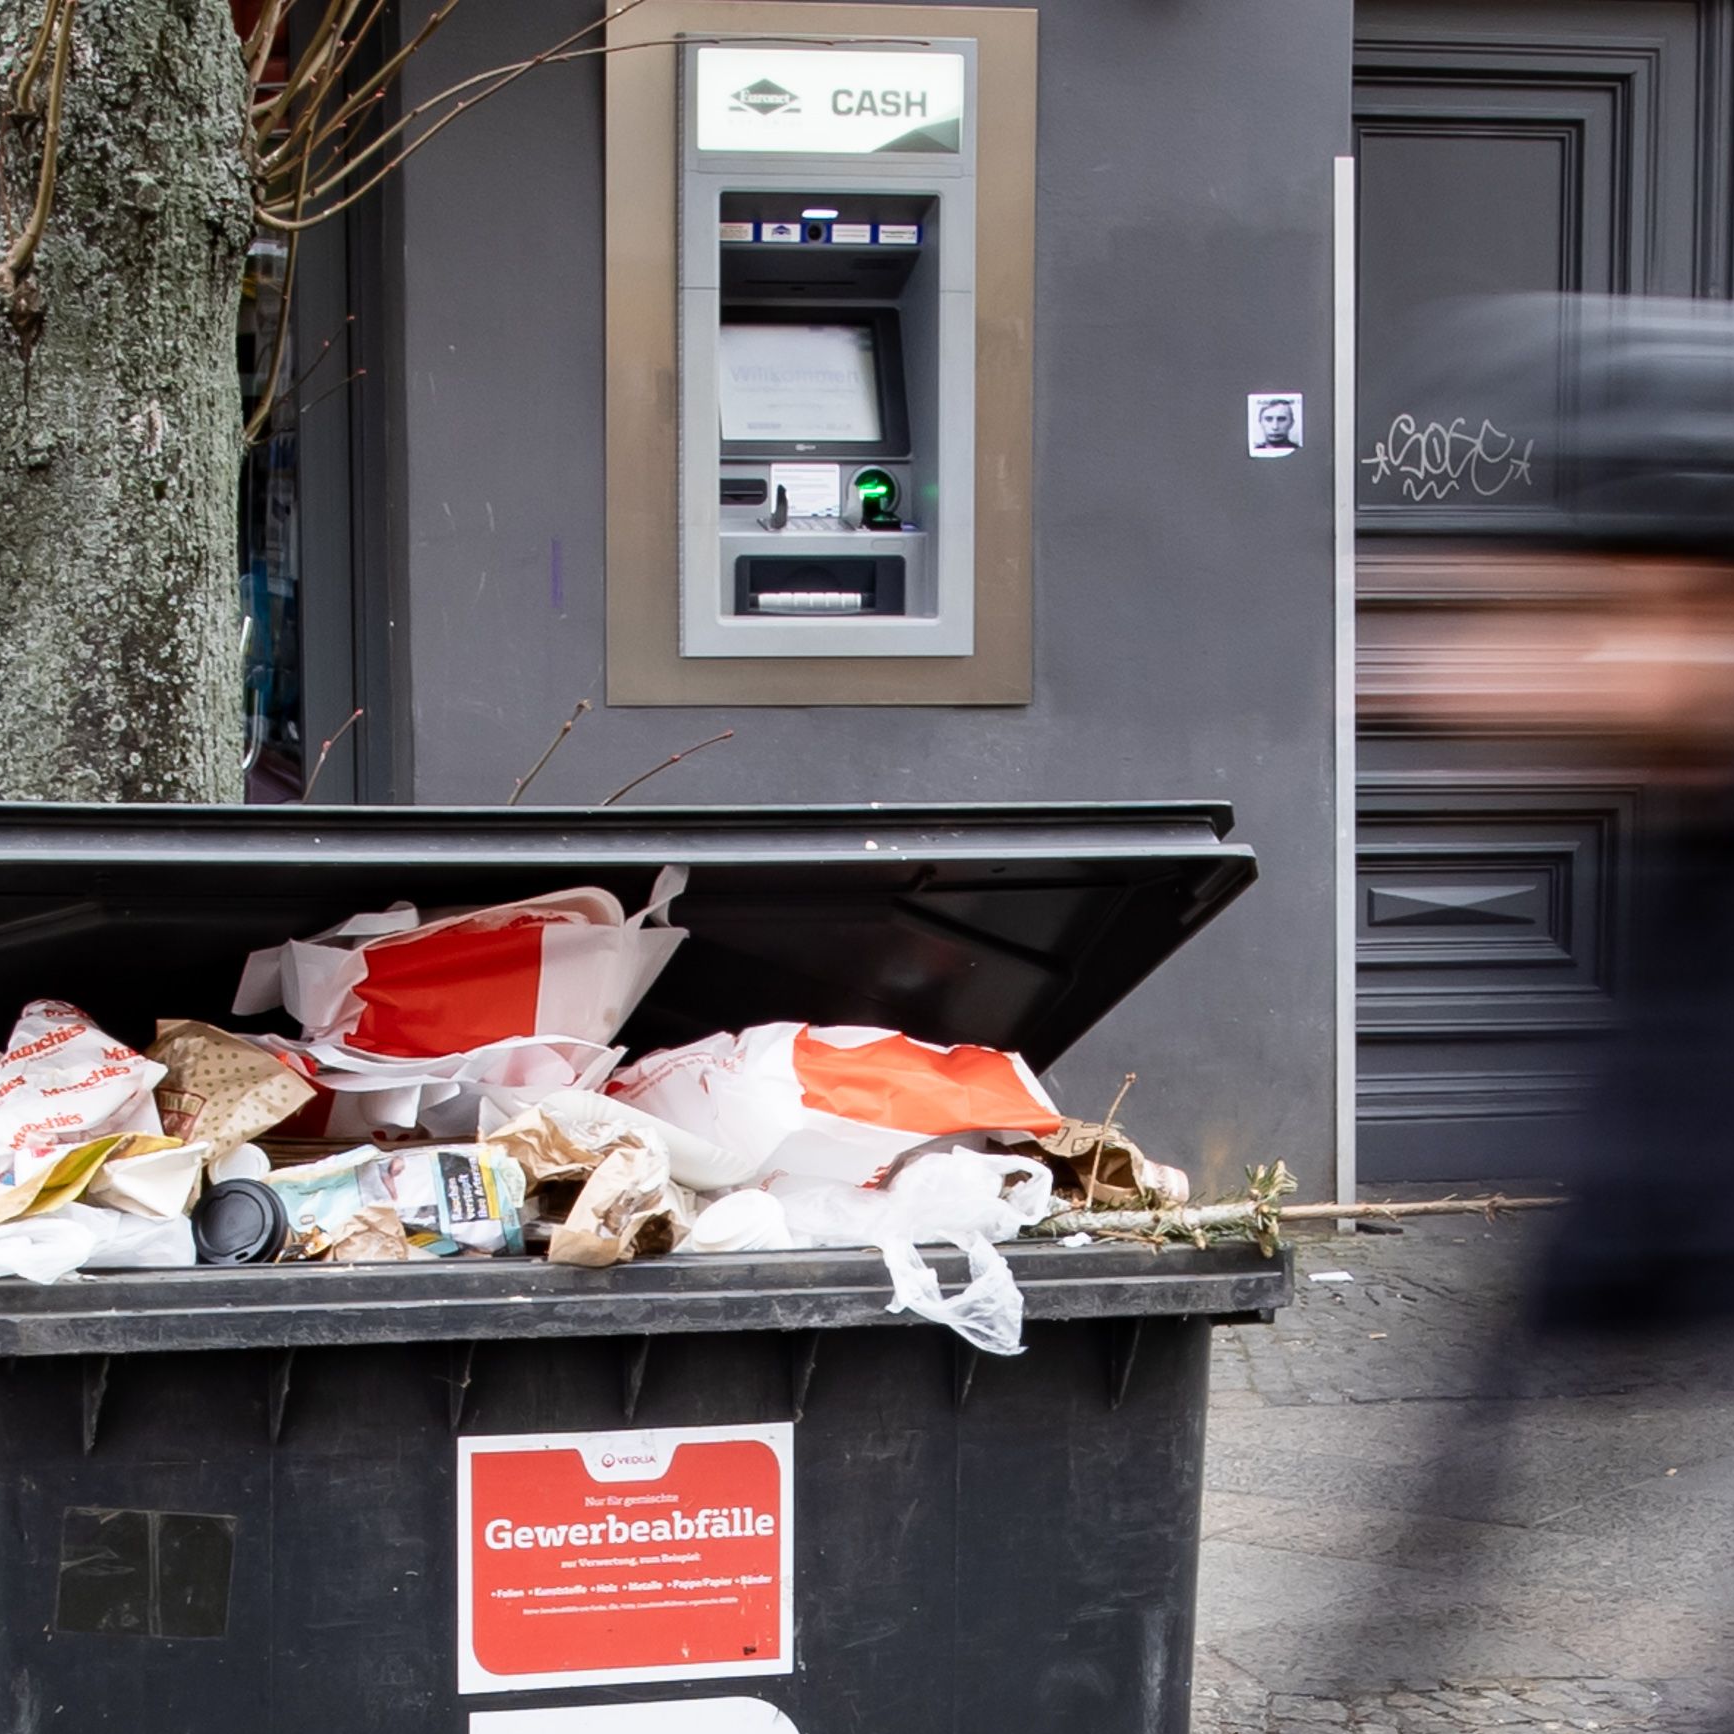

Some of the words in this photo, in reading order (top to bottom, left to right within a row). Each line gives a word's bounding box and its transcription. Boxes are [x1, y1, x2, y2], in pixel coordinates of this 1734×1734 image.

[831, 88, 928, 118] CASH
[730, 366, 859, 385] Willkommen
[583, 1495, 606, 1508] Nur
[484, 1507, 776, 1551] Gewerbeabfälle
